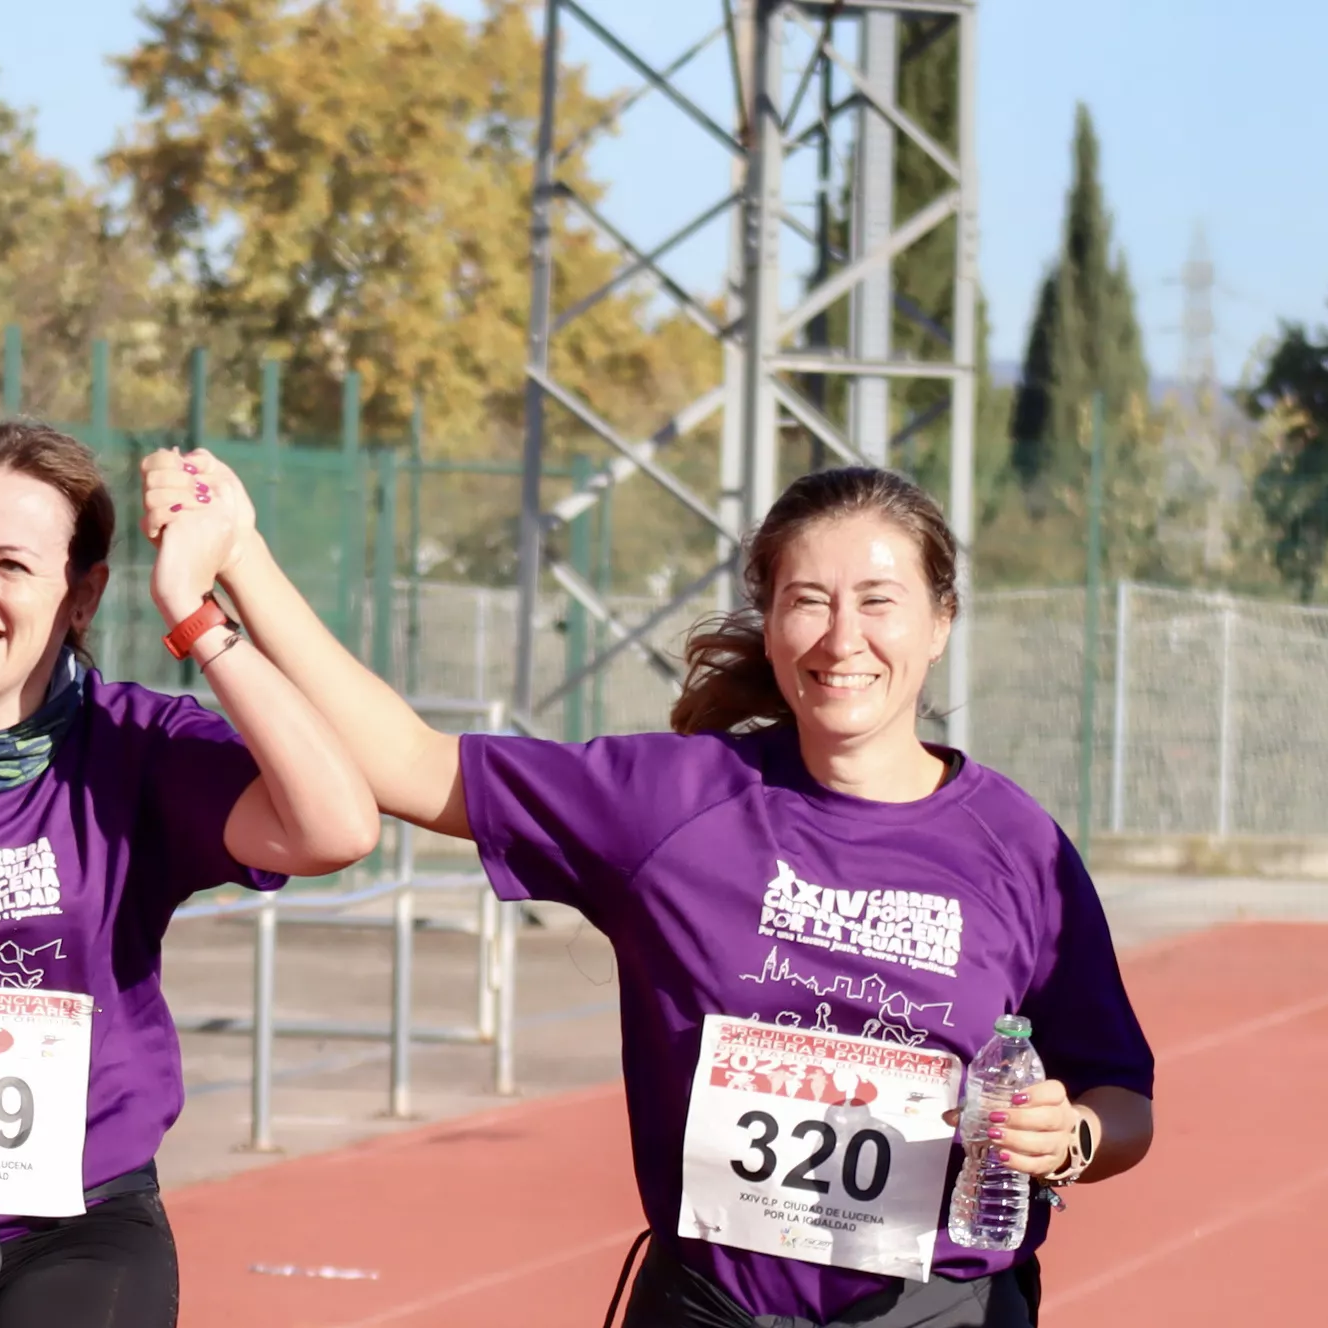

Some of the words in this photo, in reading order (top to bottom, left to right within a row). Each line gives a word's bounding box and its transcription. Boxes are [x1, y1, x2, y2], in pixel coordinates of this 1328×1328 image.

[767, 859, 868, 918] XXIV
[867, 889, 961, 915] CARRERA
[760, 905, 806, 933] POR
[813, 920, 842, 942] LA
[850, 929, 959, 967] IGUALDAD
[763, 889, 845, 927] CIUDAD
[861, 919, 961, 952] LUCENA
[865, 904, 963, 933] POPULAR
[719, 1033, 827, 1057] CARRERAS
[835, 1050, 953, 1079] POPULARES
[720, 1023, 806, 1045] CIRCUITO
[813, 1038, 920, 1062] PROVINCIAL
[713, 1050, 807, 1080] 2023
[730, 1110, 891, 1202] 320
[739, 1192, 760, 1204] XXIV
[783, 1200, 824, 1215] CIUDAD
[825, 1207, 840, 1218] DE
[841, 1210, 885, 1226] LUCENA
[764, 1209, 784, 1221] POR
[787, 1213, 800, 1223] LA
[803, 1216, 857, 1232] IGUALDAD
